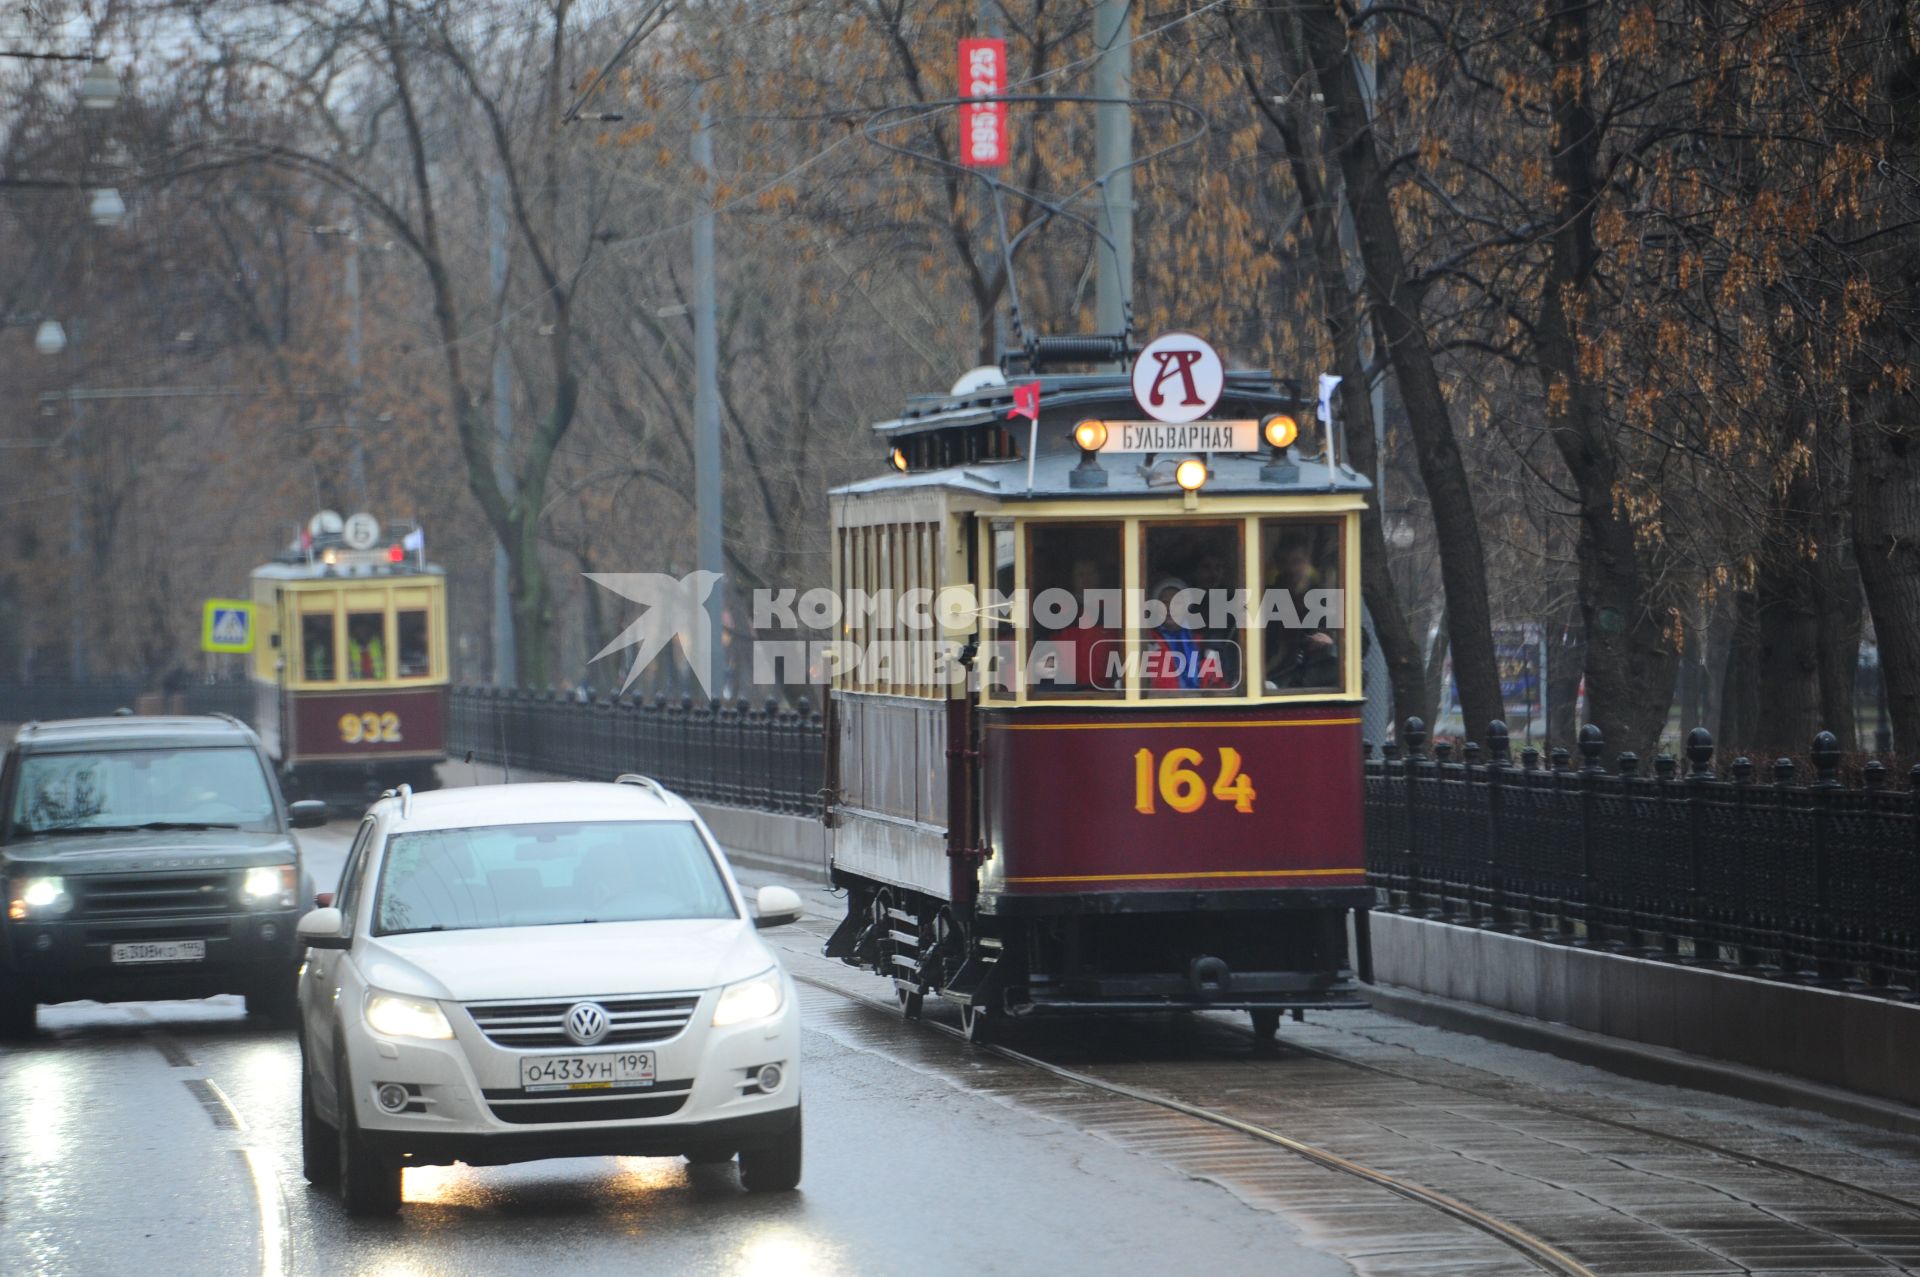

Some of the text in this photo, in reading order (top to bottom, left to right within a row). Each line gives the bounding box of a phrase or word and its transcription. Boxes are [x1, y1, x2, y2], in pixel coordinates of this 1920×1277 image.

[1122, 423, 1234, 450] БУЛЬВАРНАЯ
[338, 711, 403, 743] 932
[1134, 747, 1257, 814] 164
[618, 1054, 649, 1071] 199
